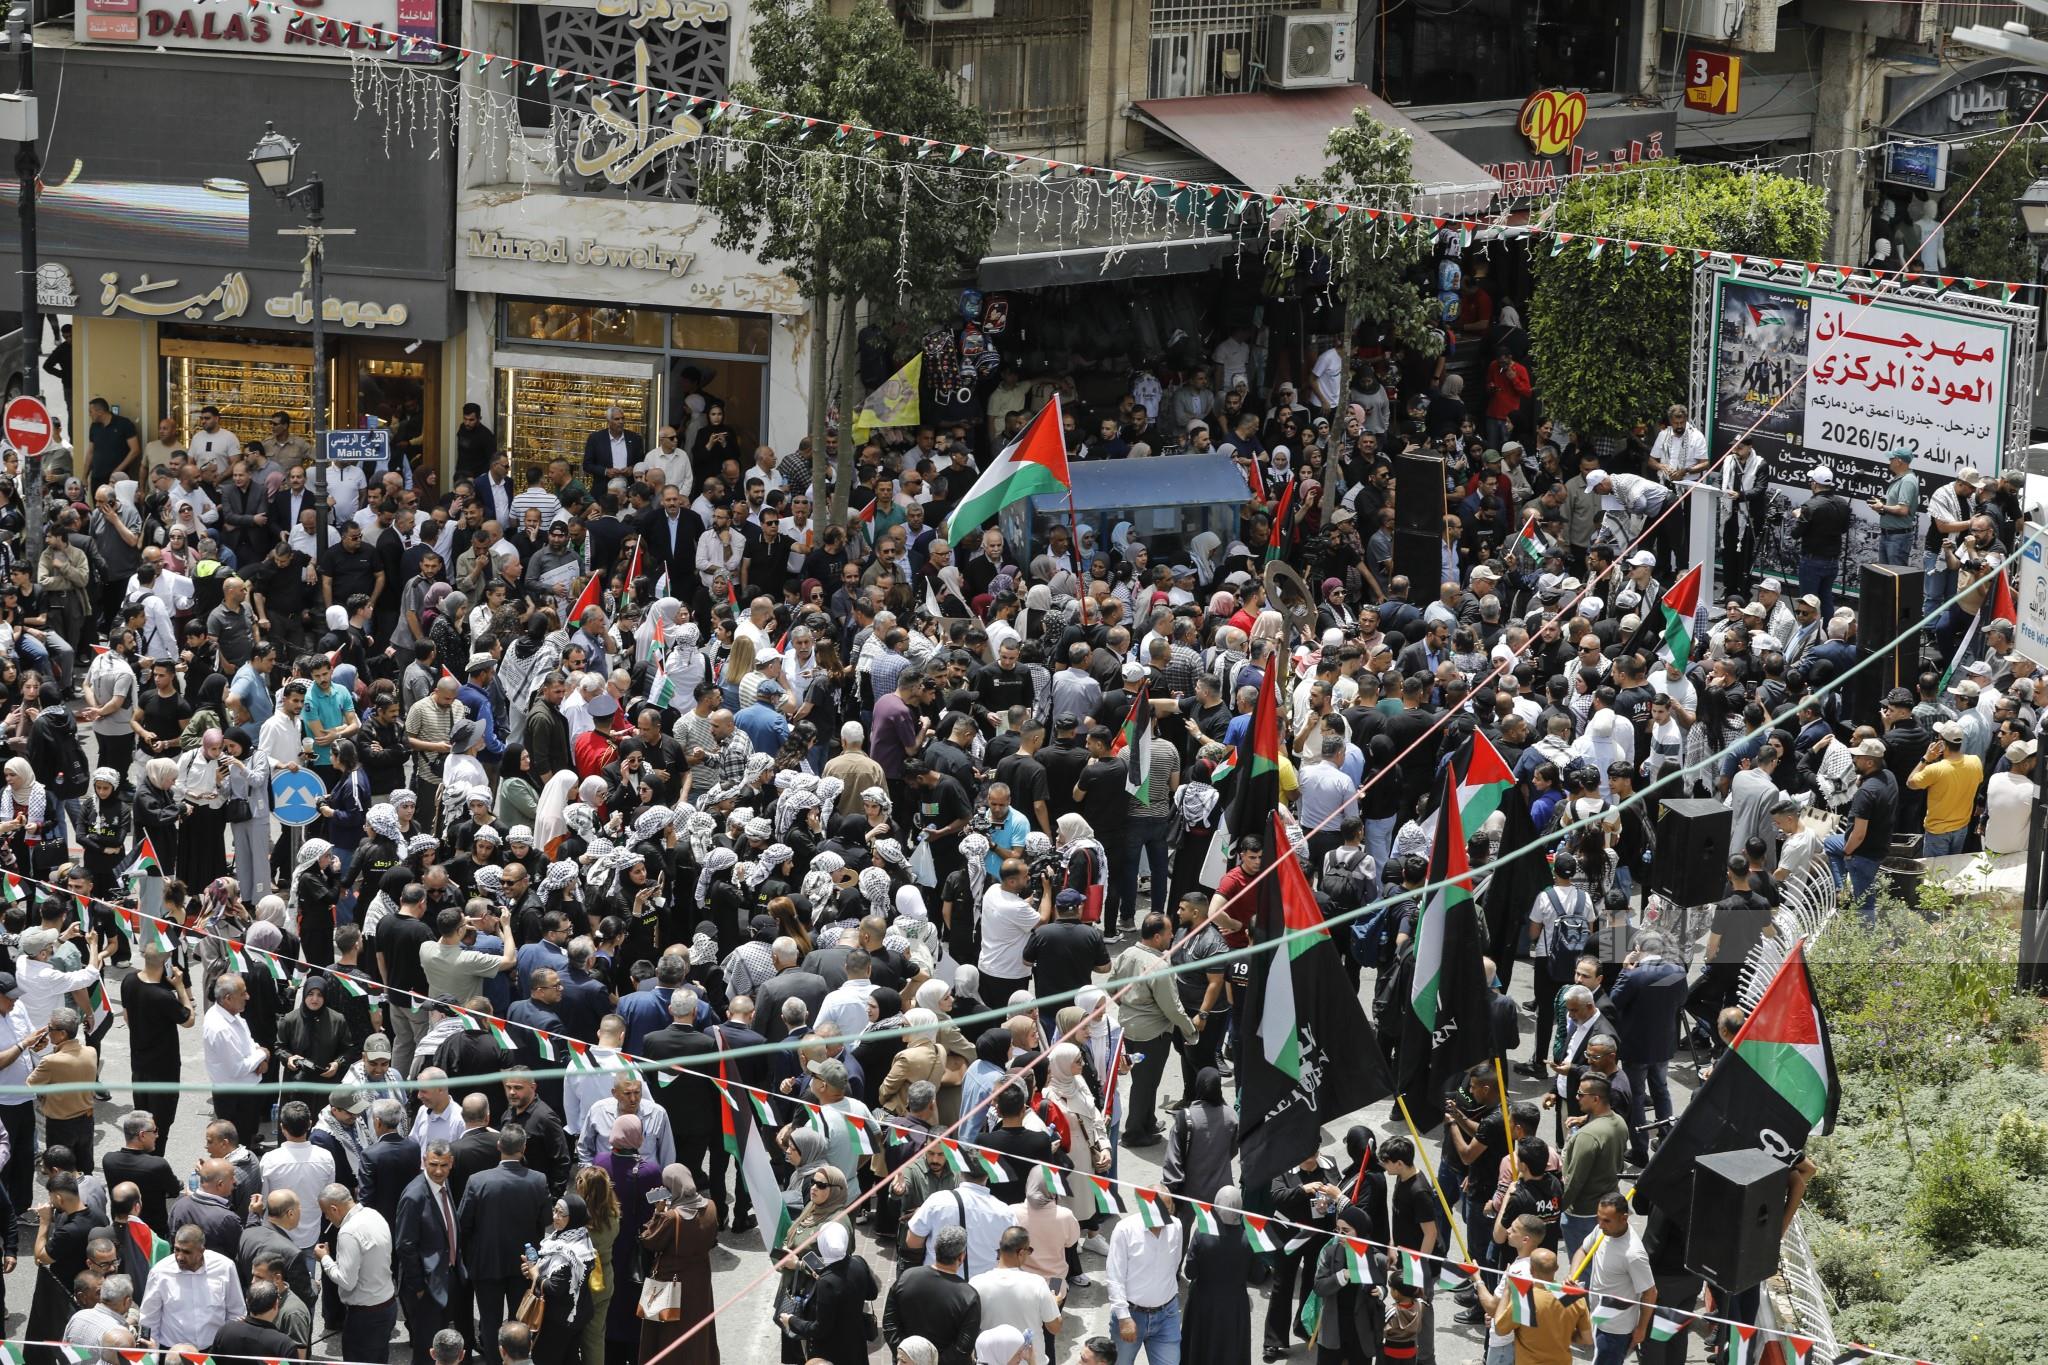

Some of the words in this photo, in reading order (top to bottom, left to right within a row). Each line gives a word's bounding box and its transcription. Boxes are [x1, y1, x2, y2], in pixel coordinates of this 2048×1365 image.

[284, 17, 388, 51] MALL
[1693, 58, 1708, 85] 3
[467, 228, 569, 264] Murad
[574, 238, 697, 278] Jewelry
[37, 295, 79, 306] WELRY
[1795, 298, 1809, 311] 78
[1815, 311, 1995, 366] مهرجان
[1812, 352, 1905, 391] المركزي
[1911, 365, 1993, 405] العودة
[1811, 394, 1848, 410] دماركم
[1849, 400, 1864, 415] من
[1865, 404, 1894, 418] أعمق
[1896, 409, 1933, 429] جذورنا
[330, 433, 359, 448] الرئيسي
[1821, 421, 1919, 458] 2026/5/12
[1976, 426, 1990, 440] لن
[337, 448, 362, 457] Main
[364, 447, 379, 457] St.
[1778, 449, 1835, 468] اللاجئين
[1924, 438, 1951, 465] الله
[1954, 453, 1977, 470] رام
[2021, 622, 2036, 641] Free
[2036, 633, 2048, 648] Wi-F
[1535, 1197, 1559, 1212] 1948
